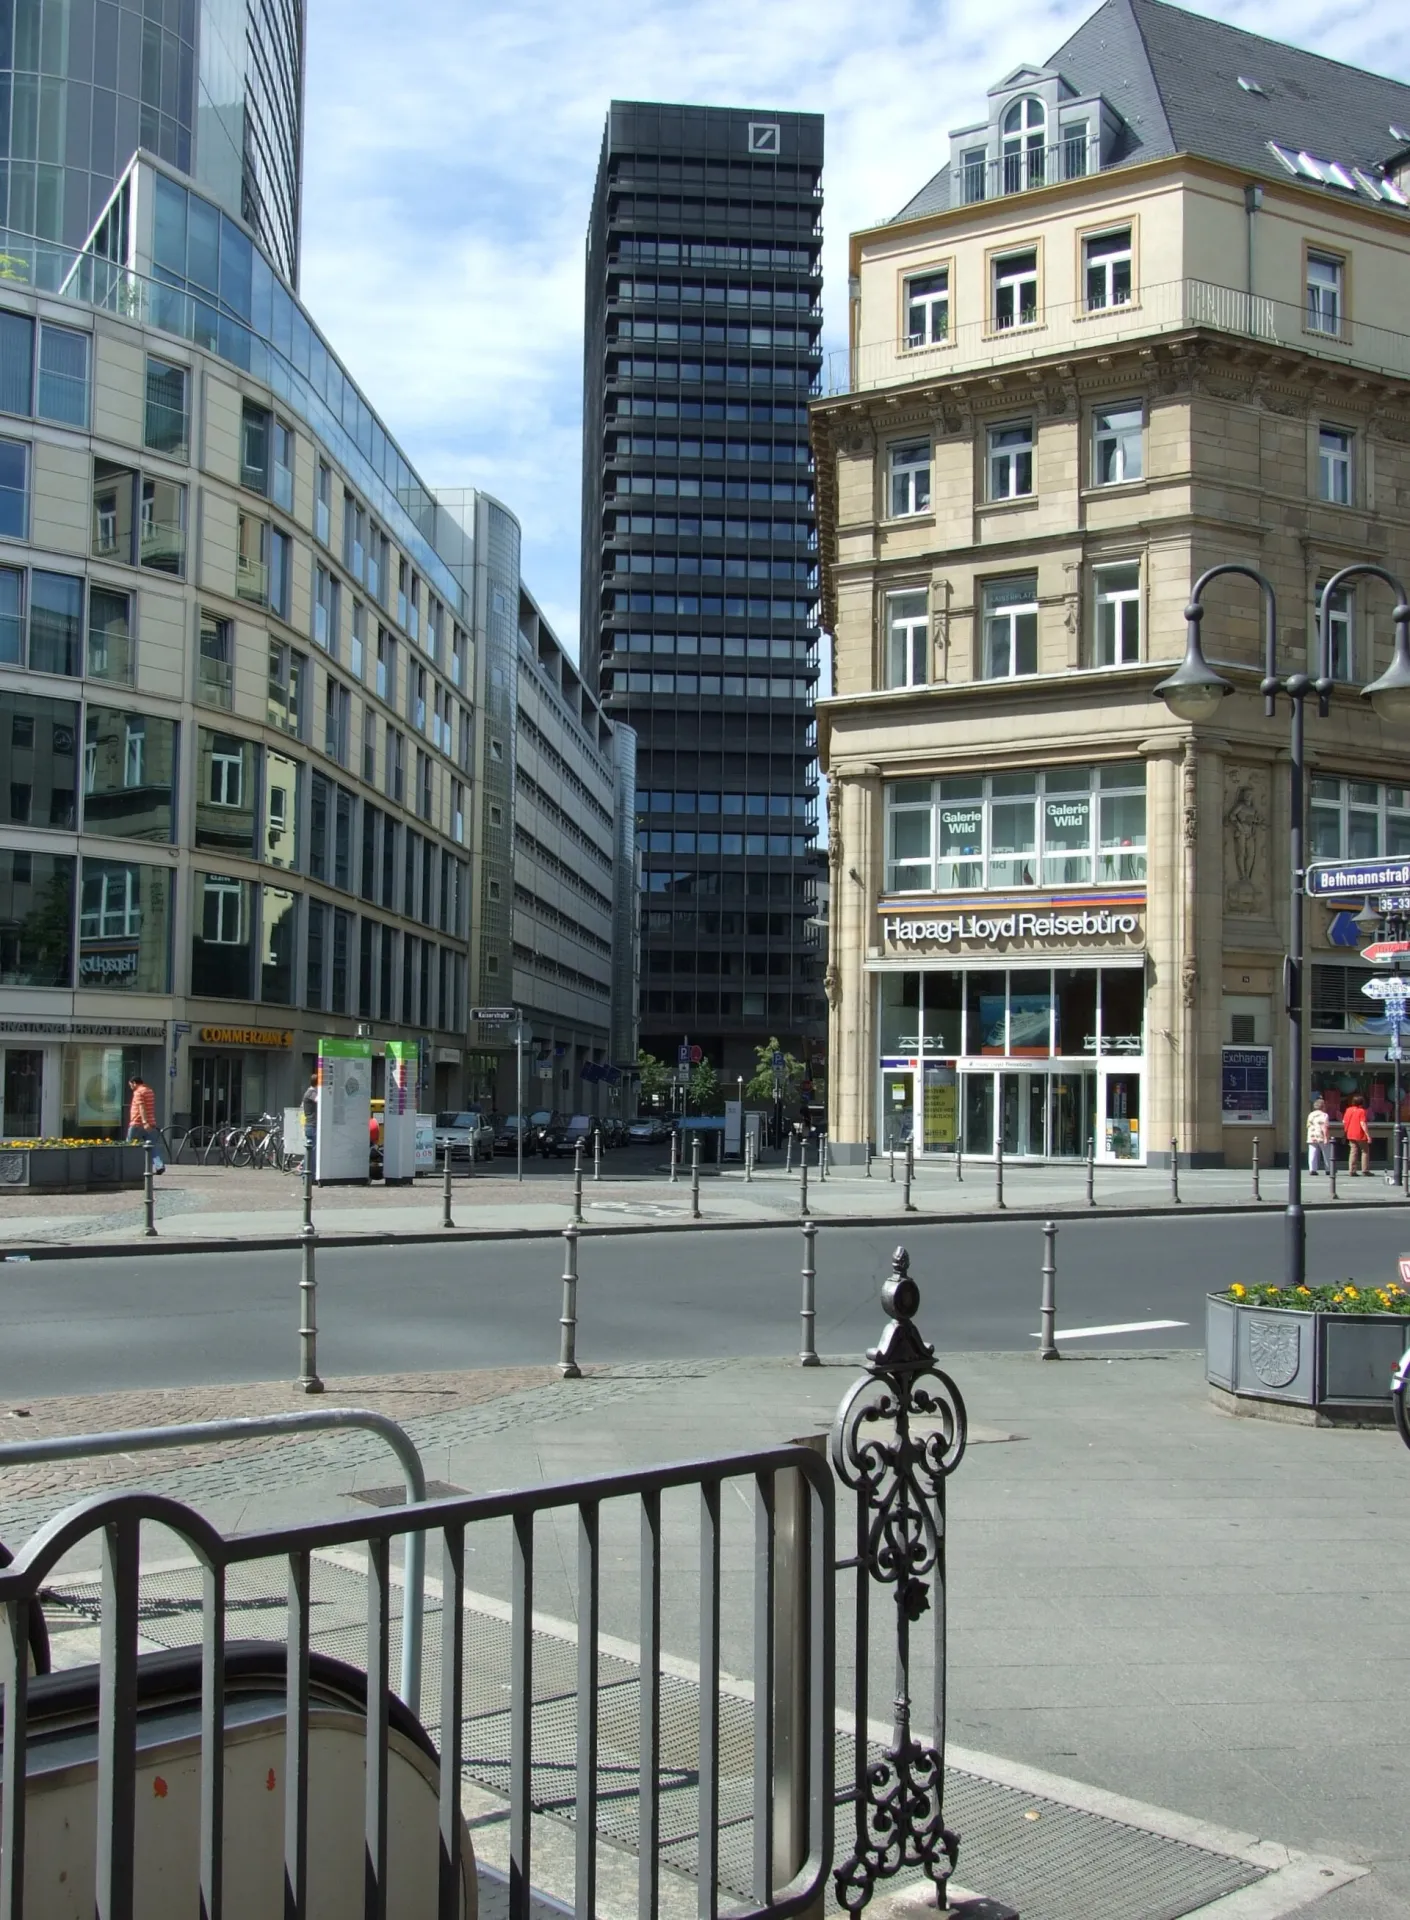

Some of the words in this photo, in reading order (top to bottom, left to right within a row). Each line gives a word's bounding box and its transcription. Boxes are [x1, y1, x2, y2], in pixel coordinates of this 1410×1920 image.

[1047, 803, 1089, 816] Galerie
[942, 811, 982, 823] Galerie
[1054, 815, 1083, 827] Wild
[948, 823, 976, 834] Wild
[884, 914, 1016, 943] Hapag-Lloyd
[1019, 911, 1136, 937] Reisebüro
[1223, 1052, 1267, 1066] Exchange
